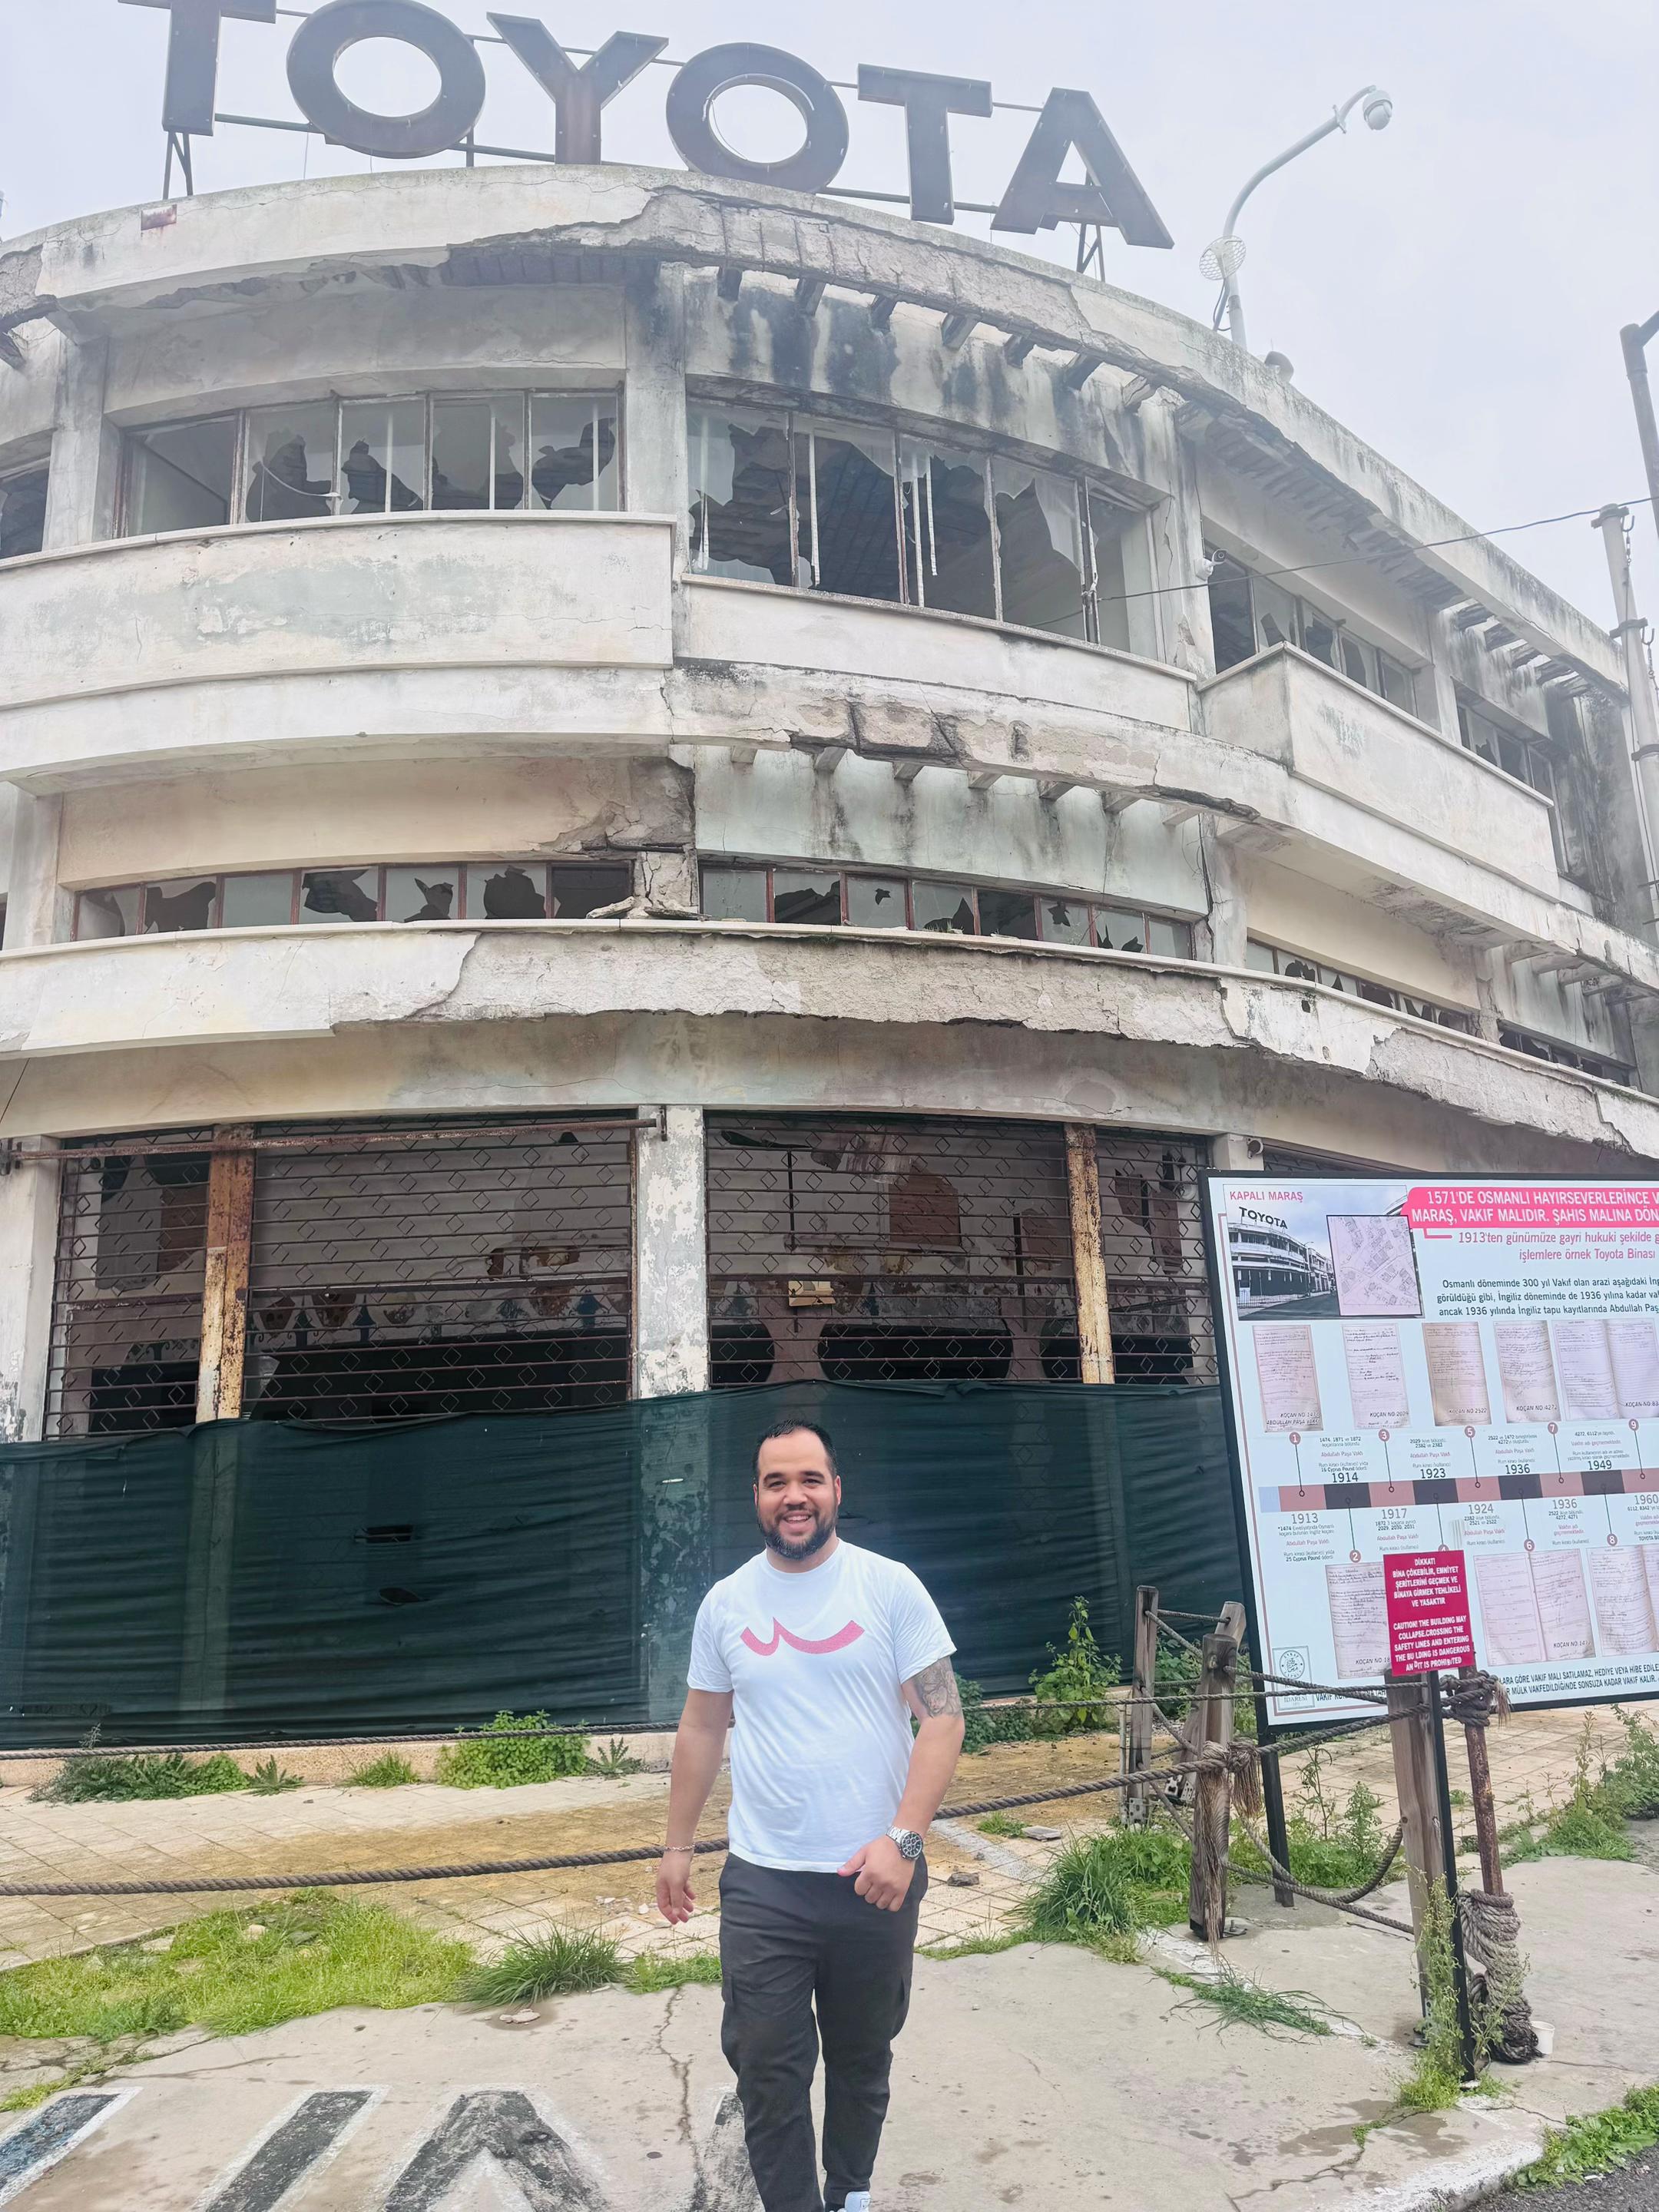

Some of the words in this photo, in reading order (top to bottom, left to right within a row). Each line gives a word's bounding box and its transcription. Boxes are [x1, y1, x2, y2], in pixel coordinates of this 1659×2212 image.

[117, 0, 1175, 248] TOYOTA
[1230, 1191, 1265, 1200] KAPALI
[1268, 1191, 1303, 1203] MARAŞ
[1427, 1190, 1475, 1204] 1571'DE
[1477, 1190, 1530, 1204] OSMANLI
[1533, 1188, 1650, 1205] HAYIRSEVERLERİNCE
[1239, 1206, 1288, 1229] TOYOTA
[1411, 1208, 1457, 1225] MARAŞ,
[1459, 1208, 1494, 1222] VAKIF
[1498, 1208, 1550, 1222] MALIDIR.
[1552, 1208, 1587, 1226] ŞAHIS
[1589, 1208, 1633, 1222] MALINA
[1459, 1231, 1503, 1243] 1913'ten
[1506, 1231, 1556, 1245] günümüze
[1559, 1231, 1581, 1245] gayri
[1584, 1231, 1617, 1243] hukuki
[1620, 1231, 1651, 1245] şekilde
[1519, 1249, 1562, 1263] işlemlere
[1565, 1248, 1591, 1259] örnek
[1594, 1248, 1624, 1261] Toyota
[1628, 1248, 1656, 1259] Binası
[1442, 1280, 1475, 1288] Osmanlı
[1477, 1279, 1521, 1287] döneminde
[1522, 1278, 1539, 1287] 300
[1541, 1278, 1551, 1288] yıl
[1551, 1278, 1571, 1286] Vakıf
[1574, 1278, 1590, 1286] olan
[1592, 1277, 1611, 1286] arazi
[1612, 1277, 1647, 1287] aşağıdaki
[1436, 1293, 1476, 1304] görüldüğü
[1479, 1293, 1496, 1303] gibi,
[1498, 1290, 1522, 1303] İngiliz
[1524, 1292, 1566, 1300] döneminde
[1581, 1291, 1601, 1300] 1936
[1604, 1291, 1624, 1301] yılına
[1626, 1290, 1647, 1299] kadar
[1439, 1307, 1463, 1316] ancak
[1465, 1306, 1488, 1315] 1936
[1489, 1306, 1515, 1316] yılında
[1518, 1304, 1541, 1316] İngiliz
[1544, 1306, 1561, 1315] tapu
[1563, 1305, 1608, 1315] kayıtlarında
[1610, 1304, 1642, 1313] Abdullah
[1549, 1424, 1555, 1432] 7
[1631, 1421, 1637, 1429] 9
[1381, 1431, 1387, 1440] 3
[1467, 1427, 1473, 1436] 5
[1292, 1434, 1298, 1443] 1
[1505, 1463, 1531, 1475] 1936
[1588, 1459, 1612, 1470] 1949
[1332, 1472, 1359, 1483] 1914
[1420, 1467, 1446, 1479] 1923
[1552, 1498, 1578, 1510] 1936
[1634, 1493, 1659, 1505] 1960
[1381, 1508, 1407, 1520] 1917
[1468, 1503, 1494, 1515] 1924
[1291, 1512, 1319, 1525] 1913
[1526, 1541, 1532, 1550] 6
[1352, 1552, 1359, 1561] 2
[1411, 1599, 1419, 1608] VE
[1419, 1618, 1429, 1628] THE
[1429, 1616, 1455, 1626] BUILDING
[1455, 1615, 1467, 1624] MAY
[1452, 1625, 1464, 1634] THE
[1394, 1641, 1414, 1651] SAFETY
[1415, 1639, 1430, 1649] LINES
[1431, 1637, 1442, 1647] AND
[1442, 1634, 1469, 1645] ENTERING
[1395, 1654, 1406, 1662] THE
[1439, 1645, 1470, 1656] DANGEROUS
[1423, 1661, 1429, 1669] IS
[1499, 1676, 1514, 1684] LARA
[1515, 1674, 1531, 1684] GÖRE
[1531, 1673, 1547, 1683] VAKIF
[1548, 1672, 1562, 1681] MALI
[1594, 1666, 1614, 1677] HEDİYE
[1614, 1666, 1629, 1675] VEYA
[1629, 1664, 1643, 1674] HİBE
[1512, 1684, 1528, 1695] MÜLK
[1578, 1679, 1604, 1689] SONSUZA
[1604, 1677, 1622, 1687] KADAR
[1622, 1676, 1638, 1685] VAKIF
[1639, 1674, 1657, 1684] KALIR.
